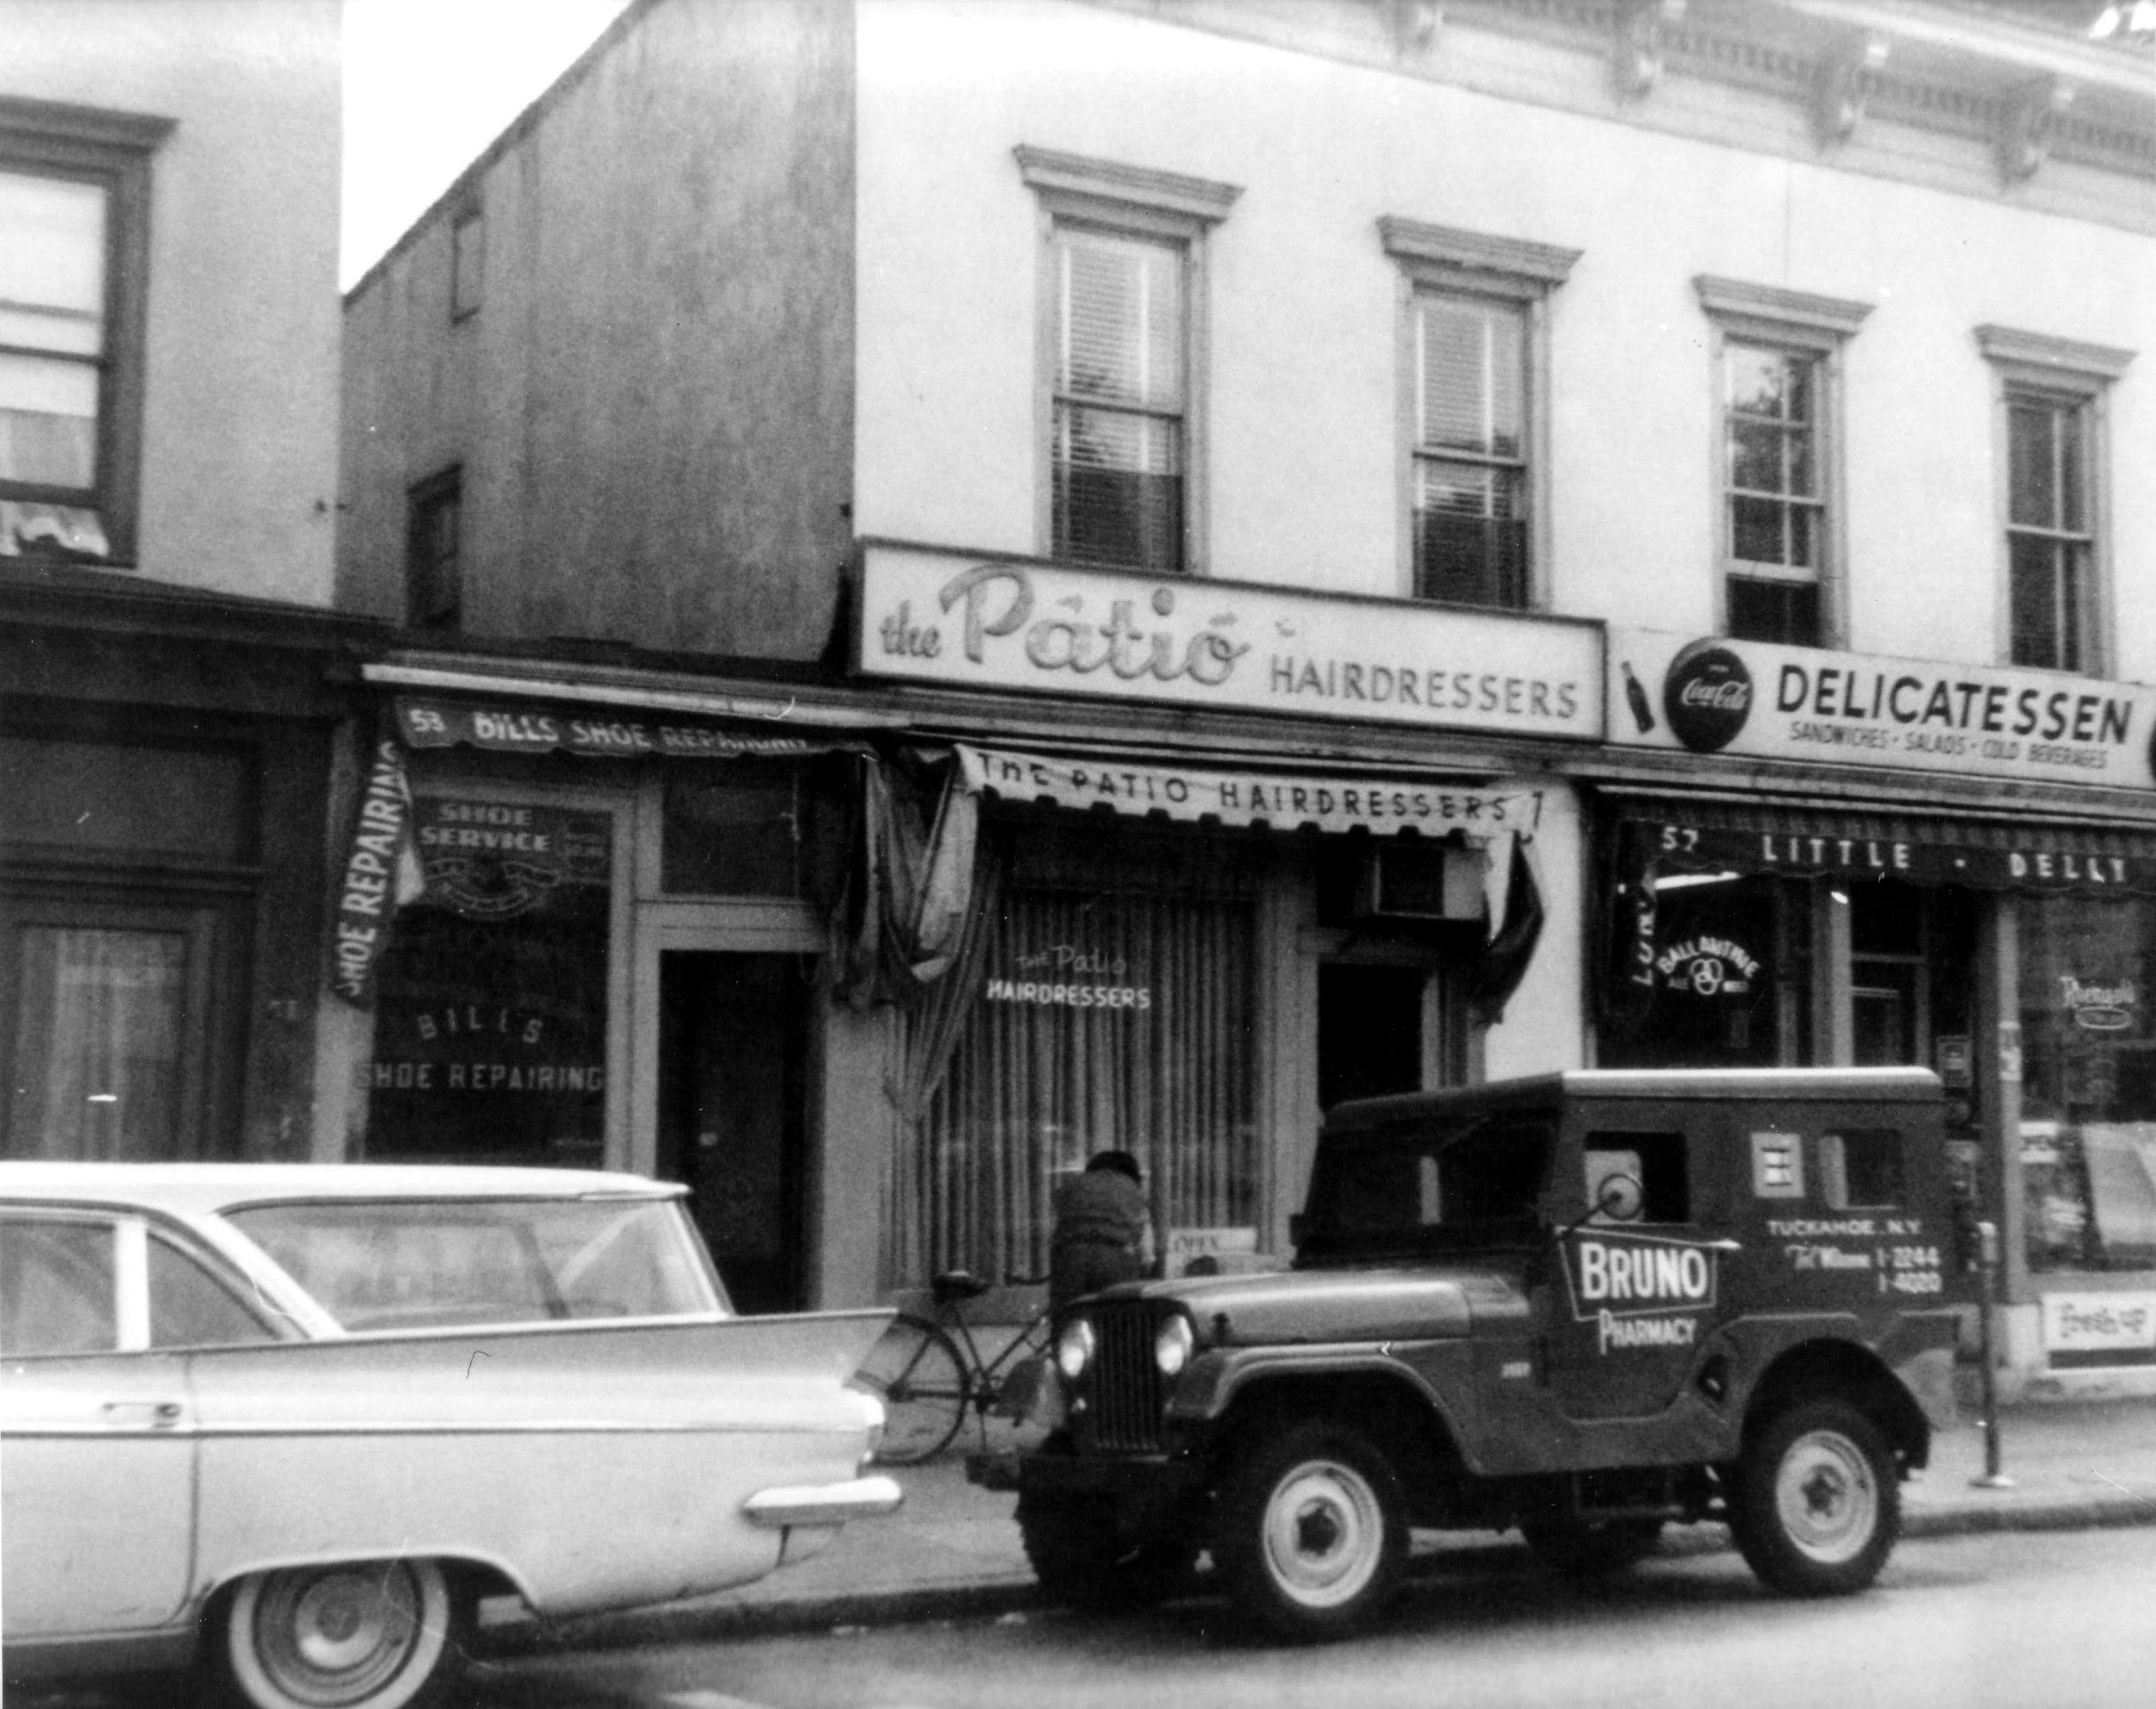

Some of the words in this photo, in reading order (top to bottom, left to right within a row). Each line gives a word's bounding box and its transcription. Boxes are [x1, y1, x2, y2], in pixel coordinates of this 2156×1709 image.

[880, 598, 942, 659] the
[940, 562, 1250, 686] Patio
[1270, 654, 1579, 720] HAIRDRESSERS
[1777, 663, 2134, 745] DELICATESSEN
[572, 719, 652, 748] SHOE
[440, 802, 533, 827] SHOE
[1071, 768, 1188, 804] PATIO
[1219, 781, 1507, 821] HAIRDRESSERS
[420, 826, 551, 853] SERVICE
[1663, 825, 1699, 853] 57
[1762, 835, 1909, 869] LITTLE
[987, 978, 1151, 1010] HAIRDRESSERS
[448, 1063, 604, 1092] REPAIRING
[1580, 1242, 1708, 1299] BRUNO
